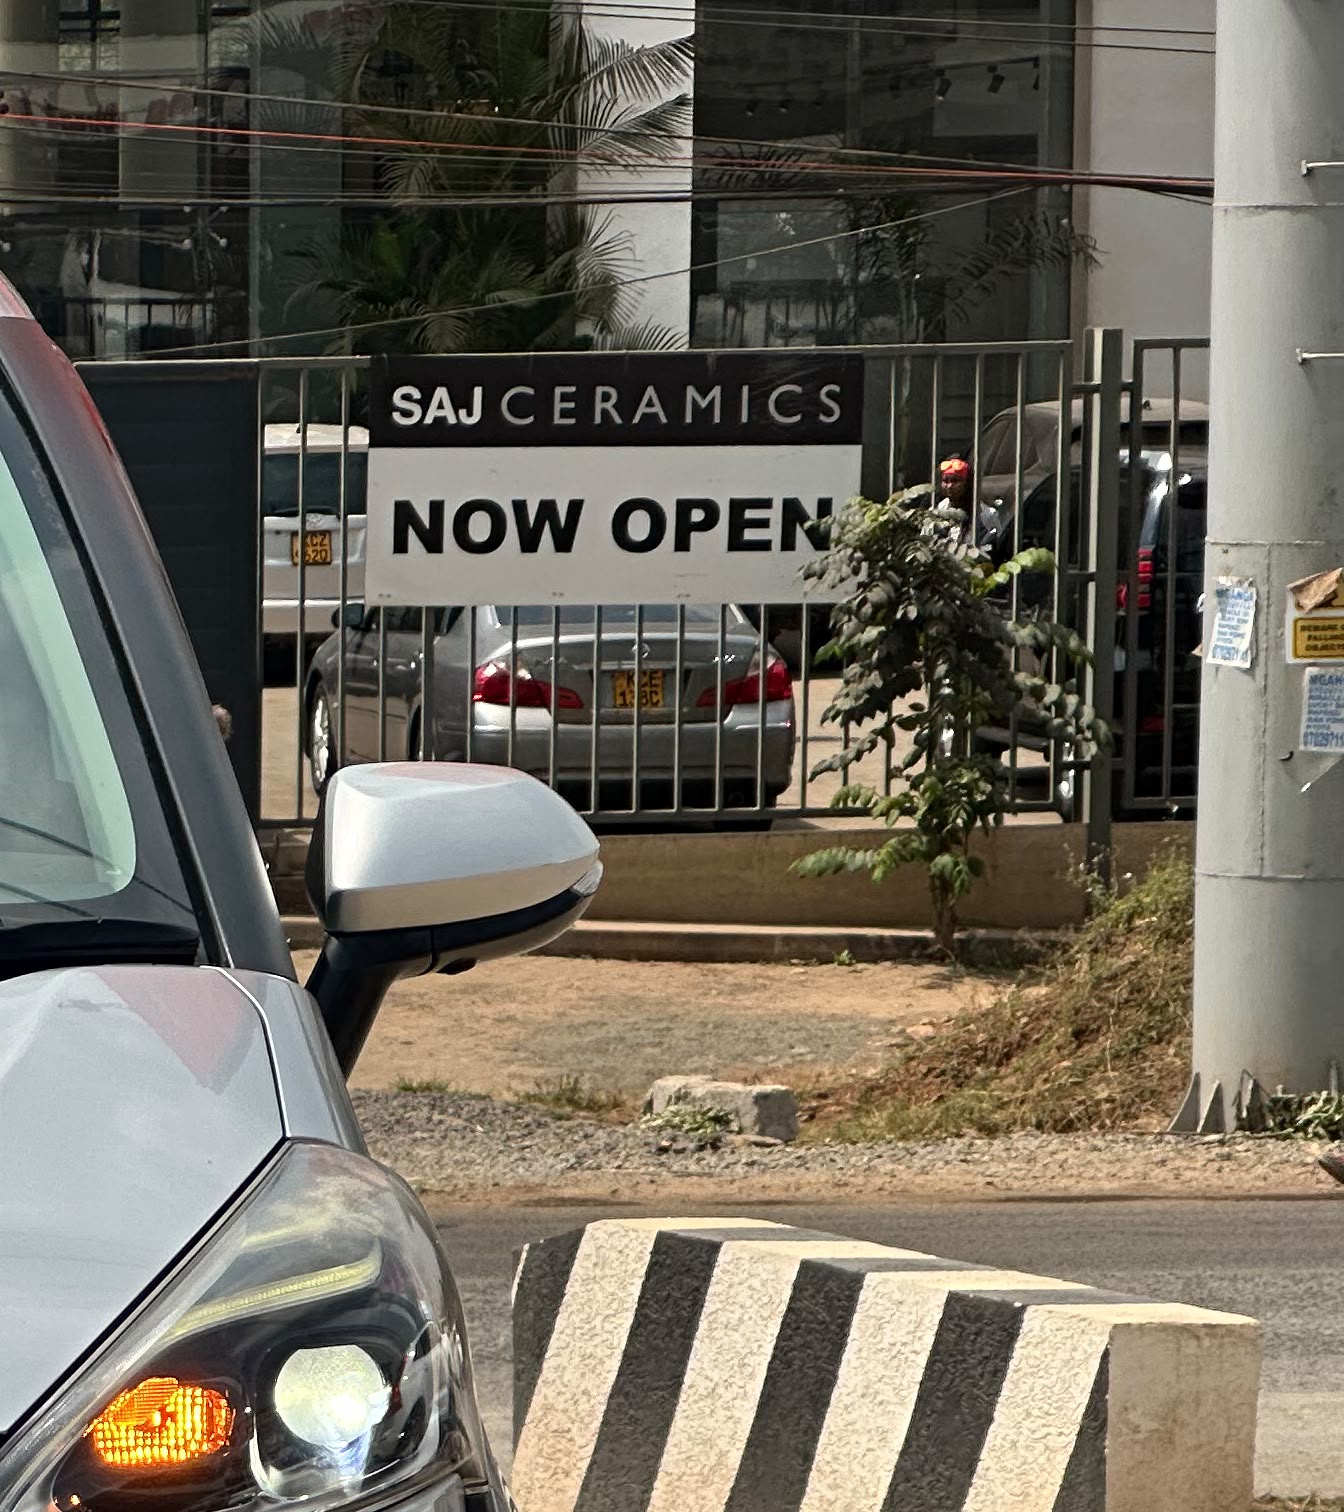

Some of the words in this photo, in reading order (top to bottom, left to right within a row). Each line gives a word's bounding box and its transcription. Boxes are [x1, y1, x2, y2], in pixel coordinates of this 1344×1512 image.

[391, 386, 483, 426] SAJ
[500, 384, 842, 426] CERAMICS
[392, 499, 584, 555] NOW
[611, 496, 833, 555] OPEN
